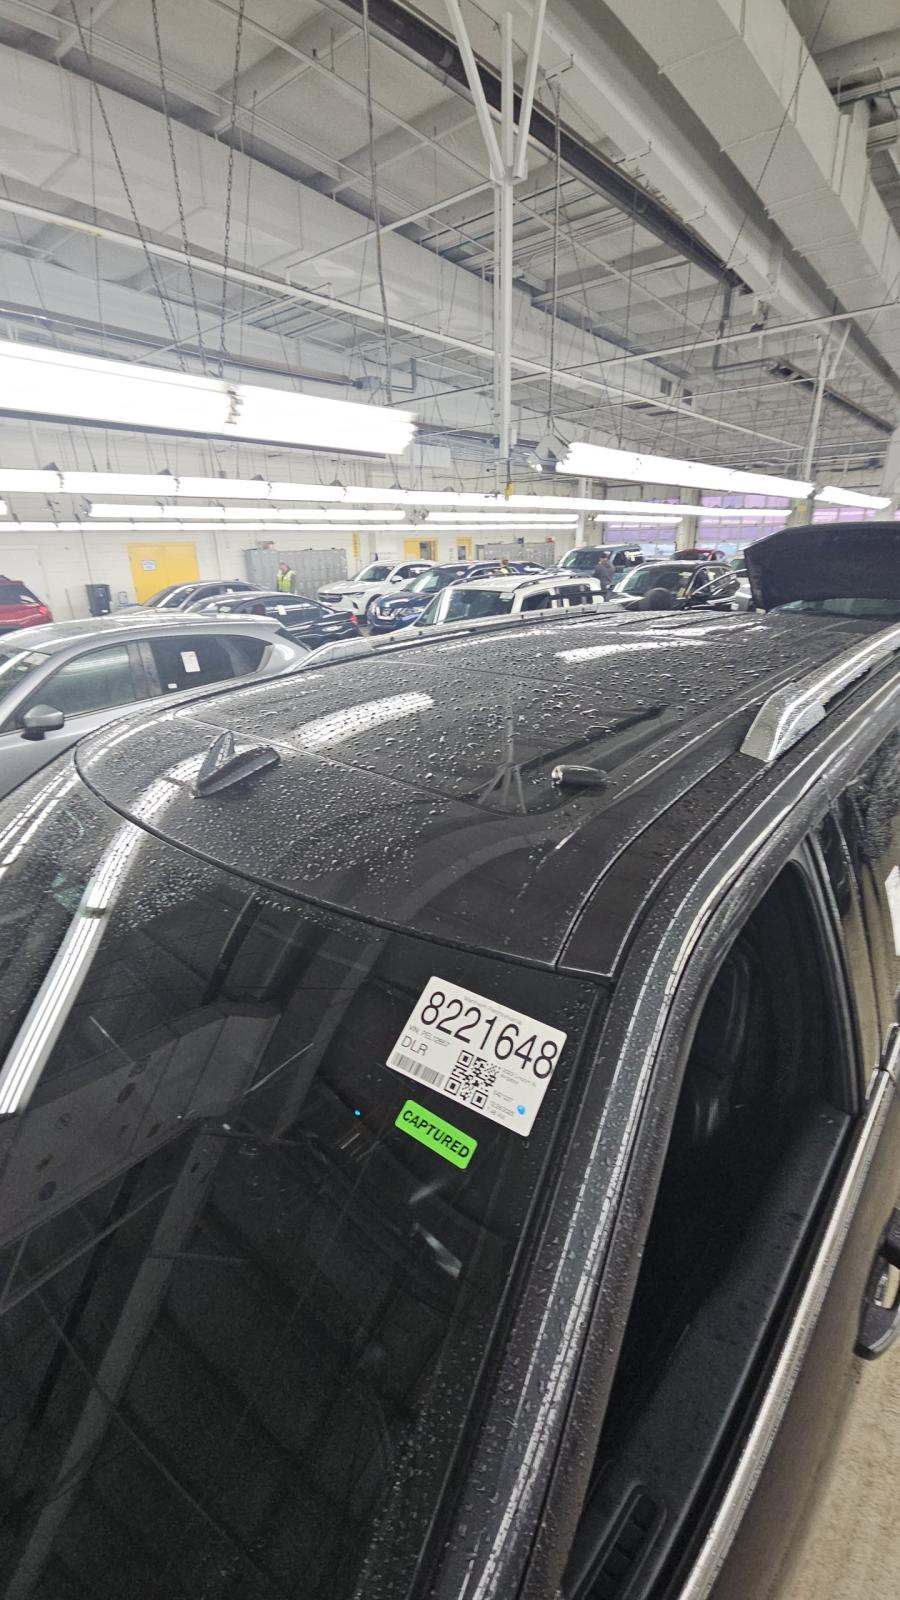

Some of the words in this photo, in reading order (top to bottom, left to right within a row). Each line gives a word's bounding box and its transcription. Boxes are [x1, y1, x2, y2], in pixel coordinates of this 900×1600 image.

[401, 1035, 428, 1056] DLR
[421, 991, 558, 1079] 8221648
[402, 1110, 470, 1158] CAPTURED
